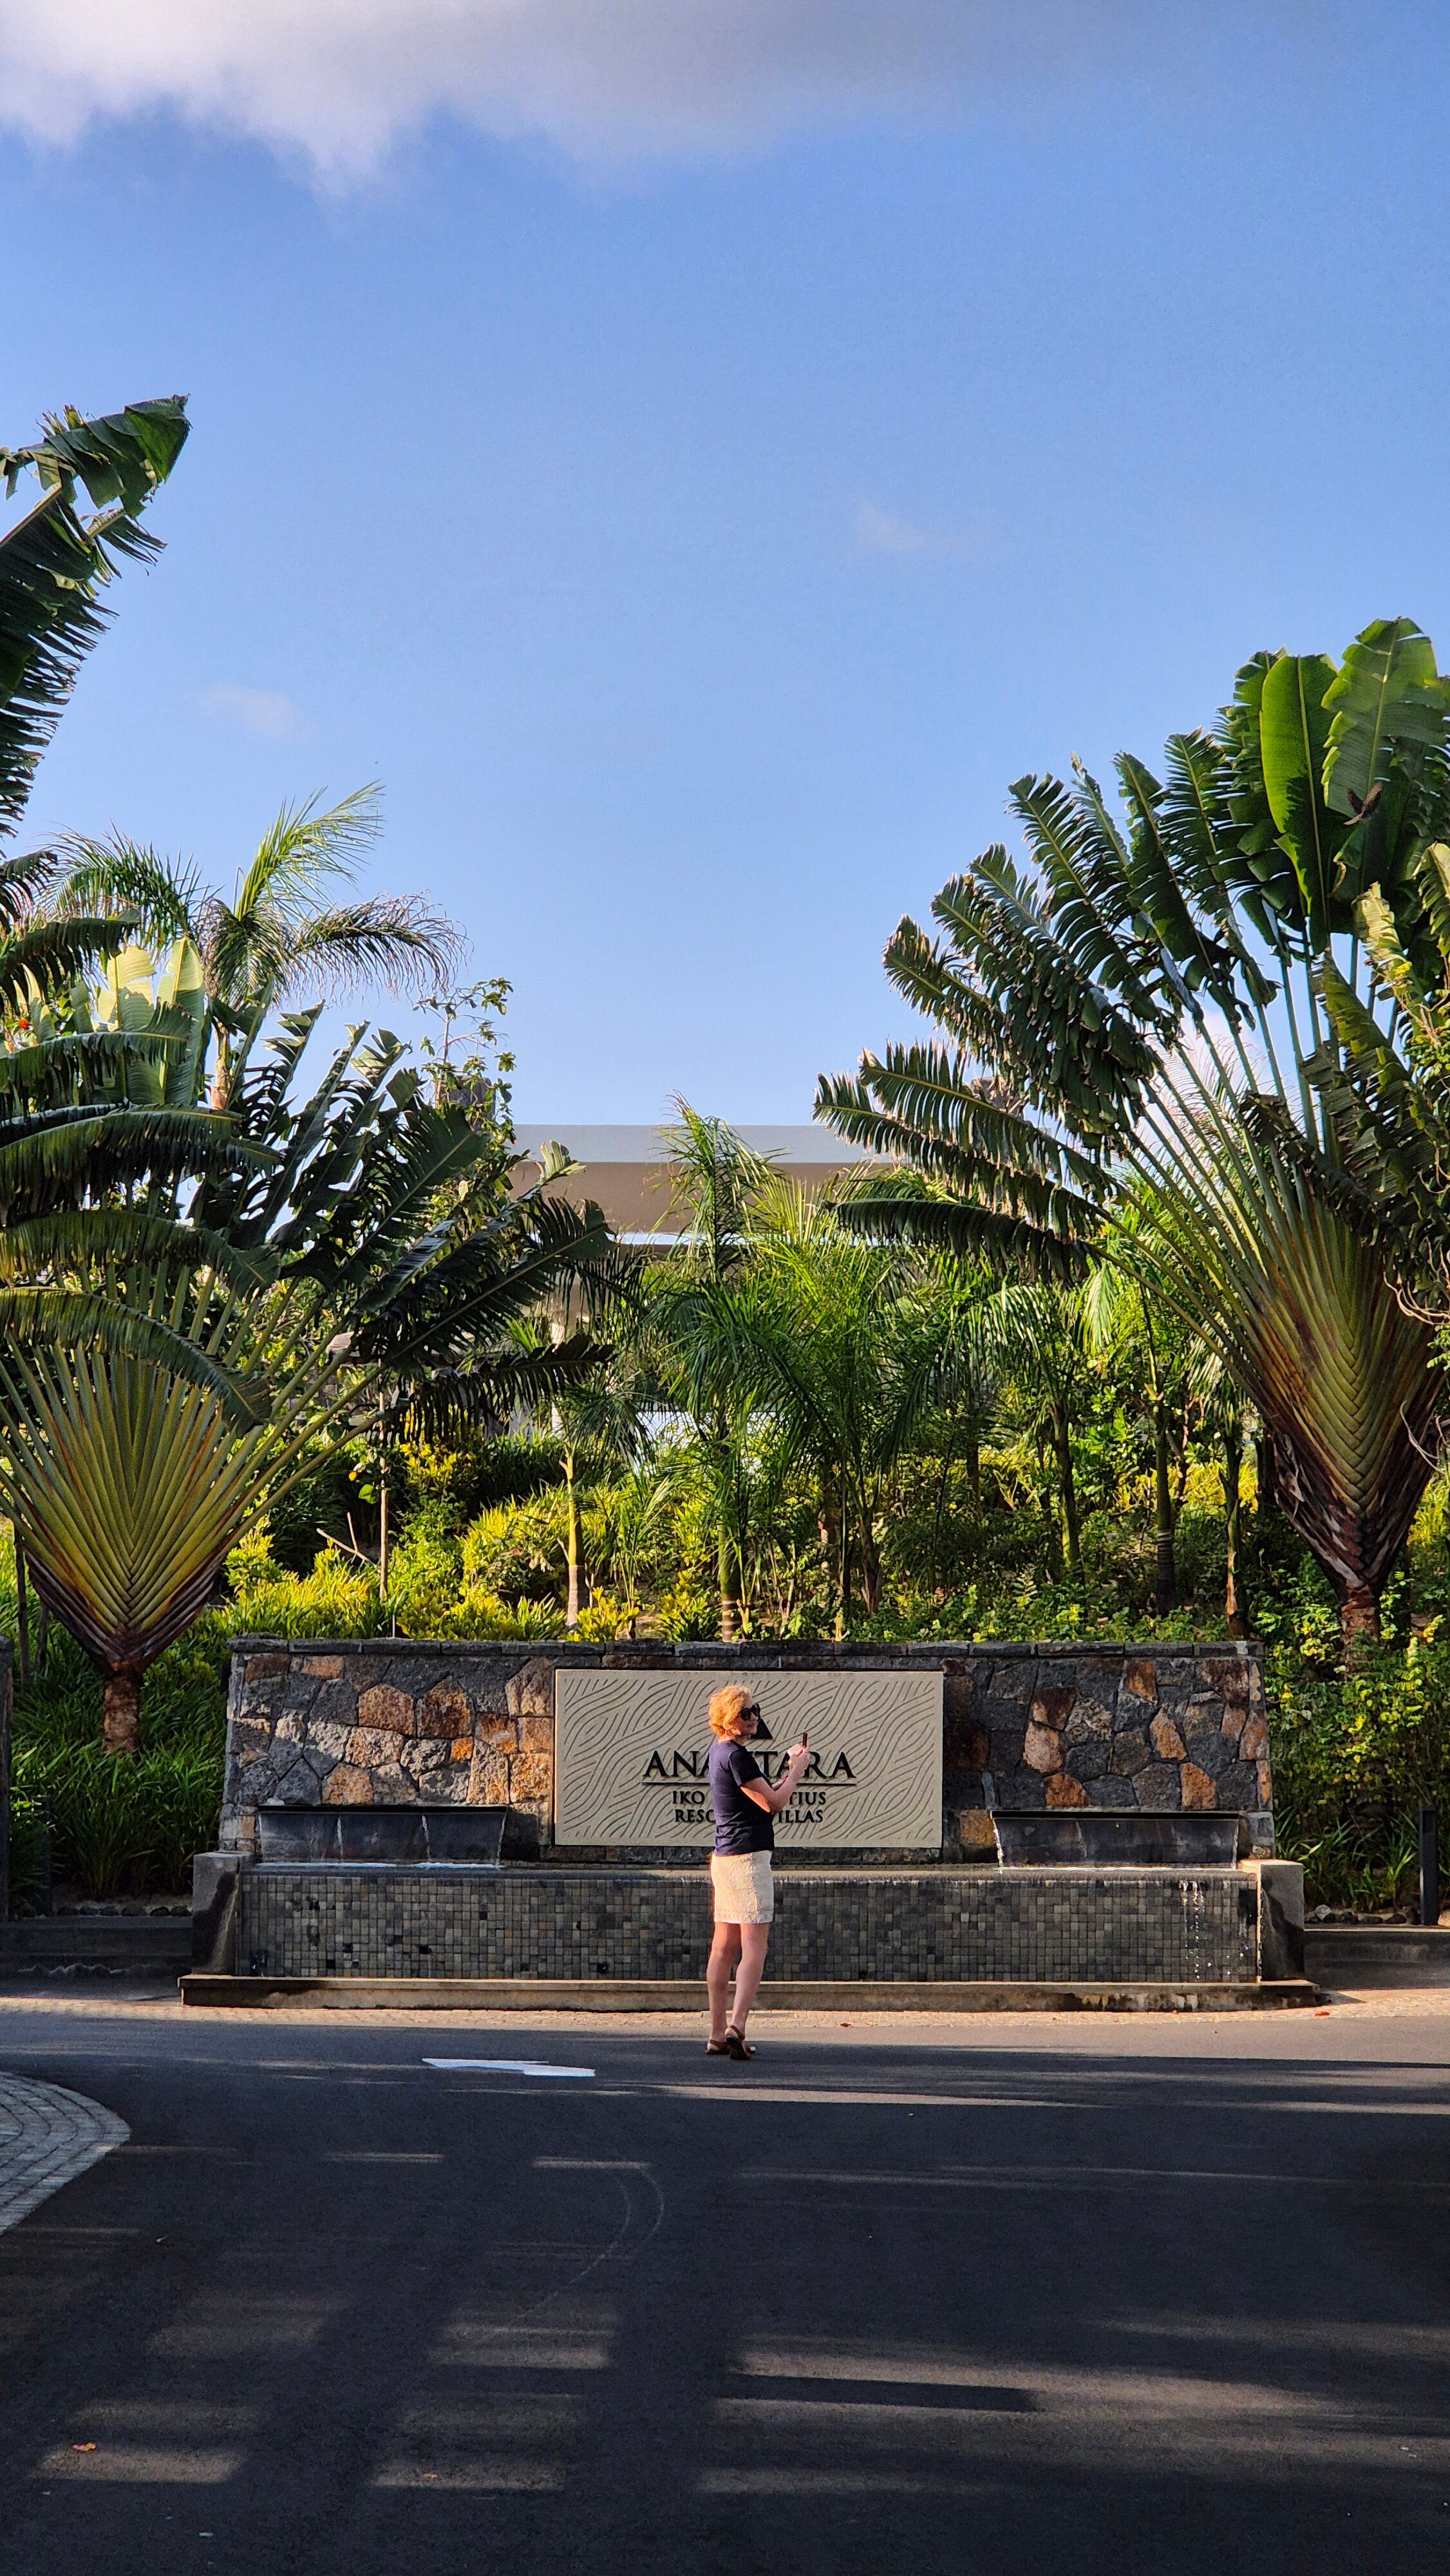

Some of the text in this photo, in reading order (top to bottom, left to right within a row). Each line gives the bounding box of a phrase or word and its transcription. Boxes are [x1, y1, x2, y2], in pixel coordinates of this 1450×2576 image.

[643, 1750, 856, 1778] ANTARA
[672, 1790, 706, 1804] IKO
[674, 1808, 824, 1824] RESO ILLAS
